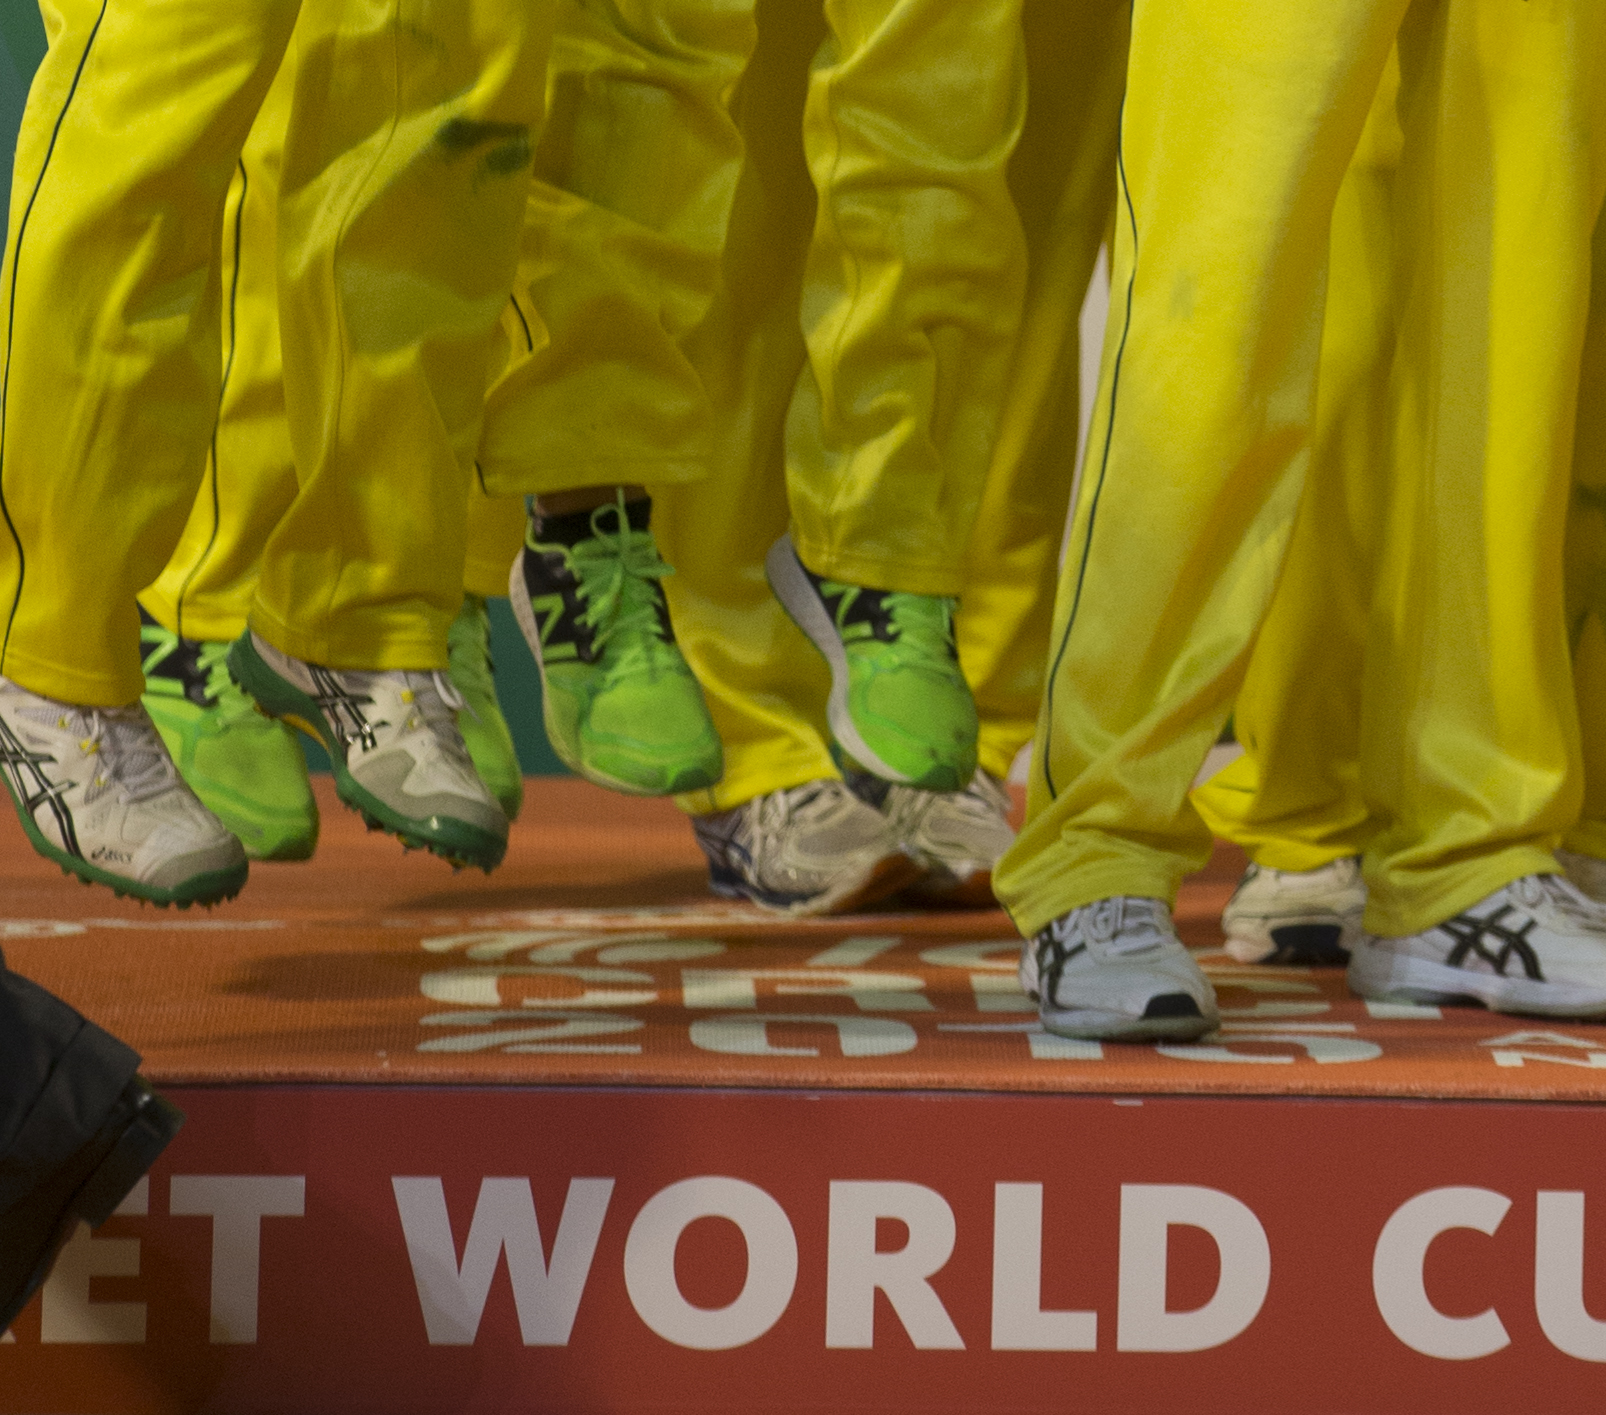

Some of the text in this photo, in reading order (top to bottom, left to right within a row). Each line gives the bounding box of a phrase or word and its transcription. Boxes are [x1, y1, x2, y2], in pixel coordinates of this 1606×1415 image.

[416, 1009, 1384, 1065] 2015
[0, 1174, 306, 1345] ET
[390, 1175, 1272, 1353] WORLD
